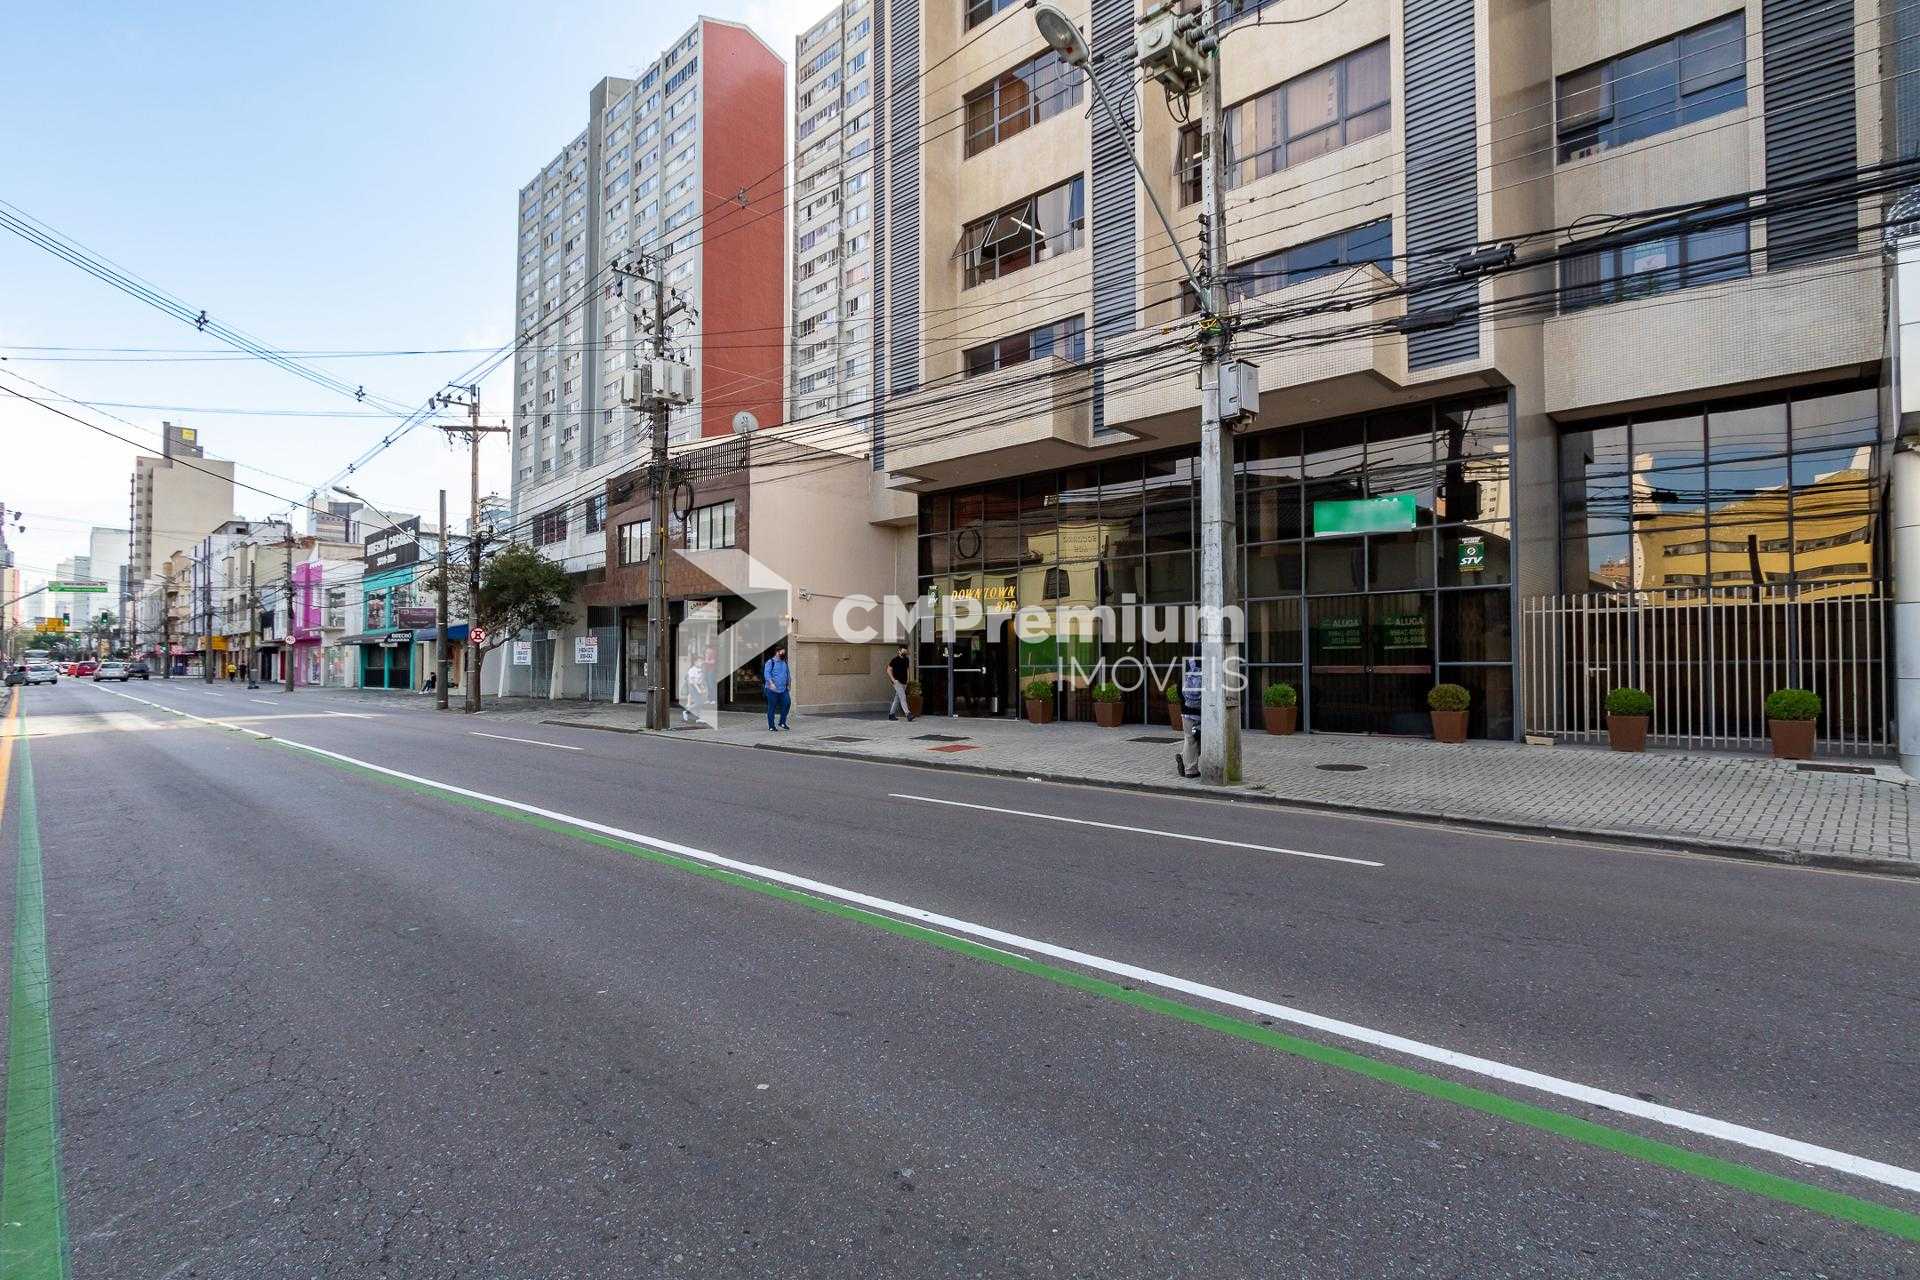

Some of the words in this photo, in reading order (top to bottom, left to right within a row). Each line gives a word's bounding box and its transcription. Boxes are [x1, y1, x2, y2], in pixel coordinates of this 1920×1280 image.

[1460, 556, 1483, 565] STV
[951, 585, 1016, 601] DOWNTOWN
[1332, 618, 1360, 628] ALUGA
[1394, 617, 1425, 626] ALUGA
